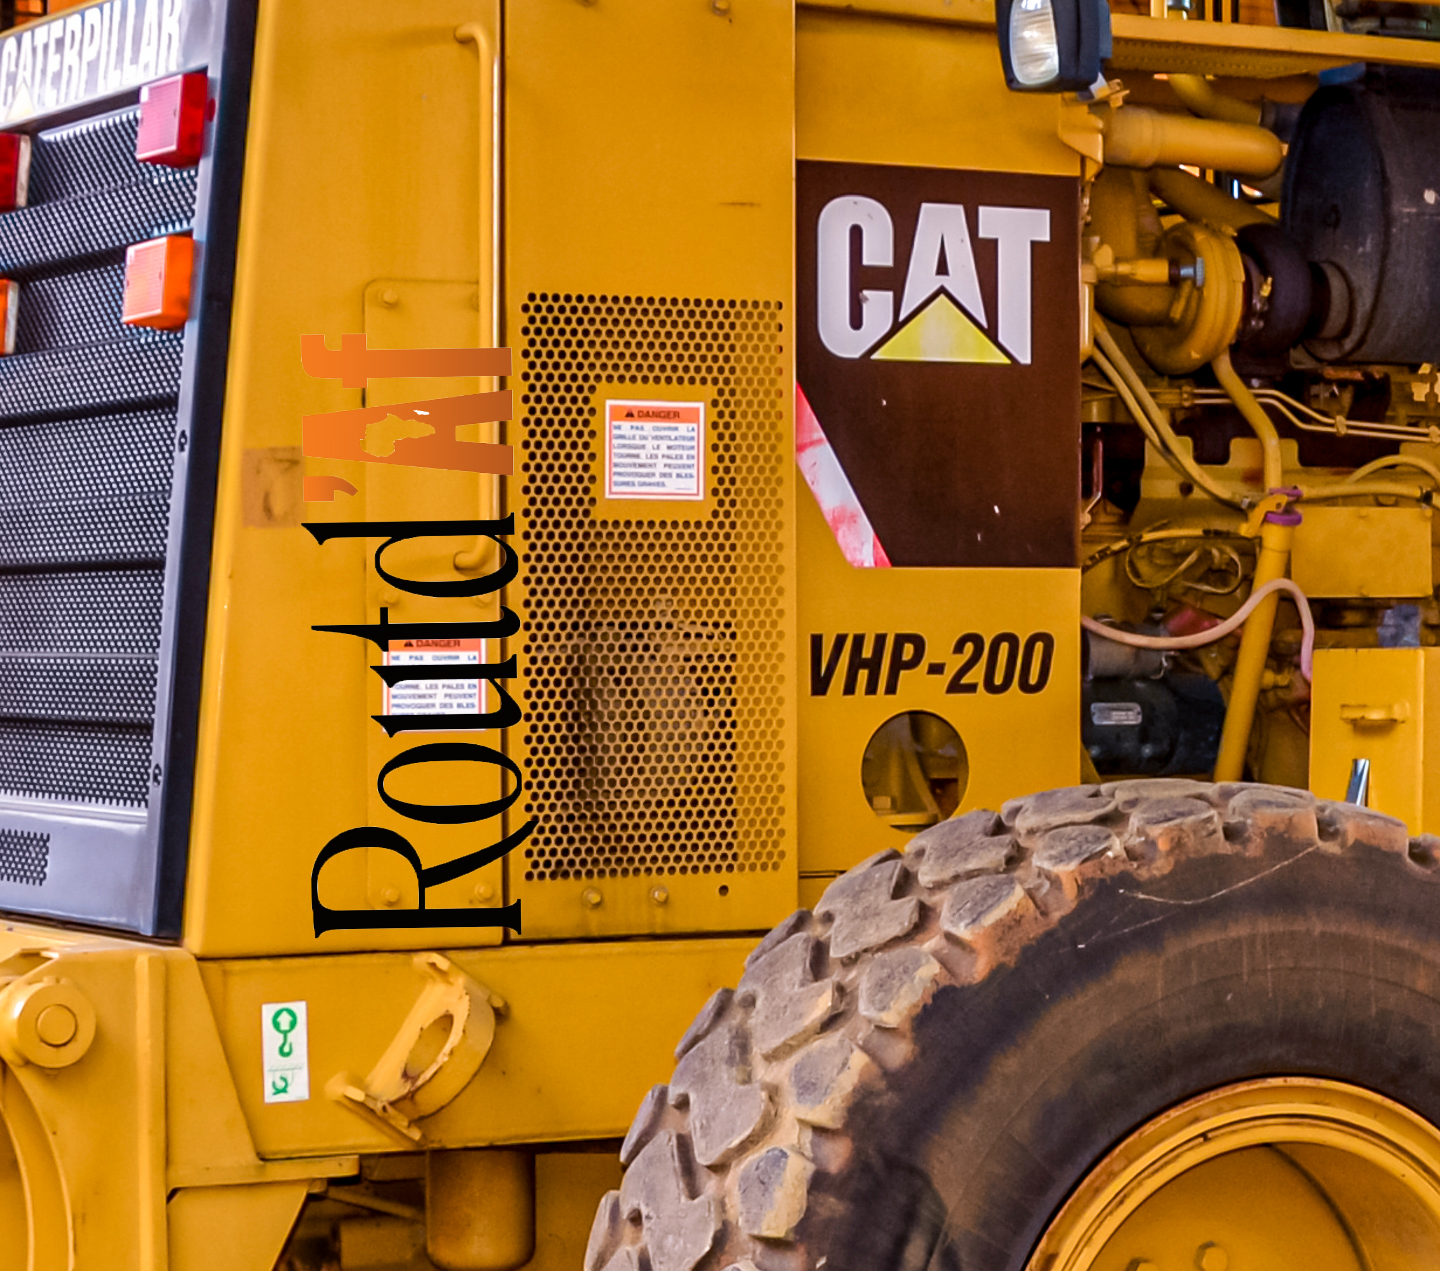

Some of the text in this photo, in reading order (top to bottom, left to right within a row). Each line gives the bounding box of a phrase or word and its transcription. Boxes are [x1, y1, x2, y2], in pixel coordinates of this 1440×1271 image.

[817, 194, 1051, 365] CAT
[637, 410, 680, 419] DANGER
[416, 639, 461, 648] DANGER
[810, 631, 1055, 697] VHP-200
